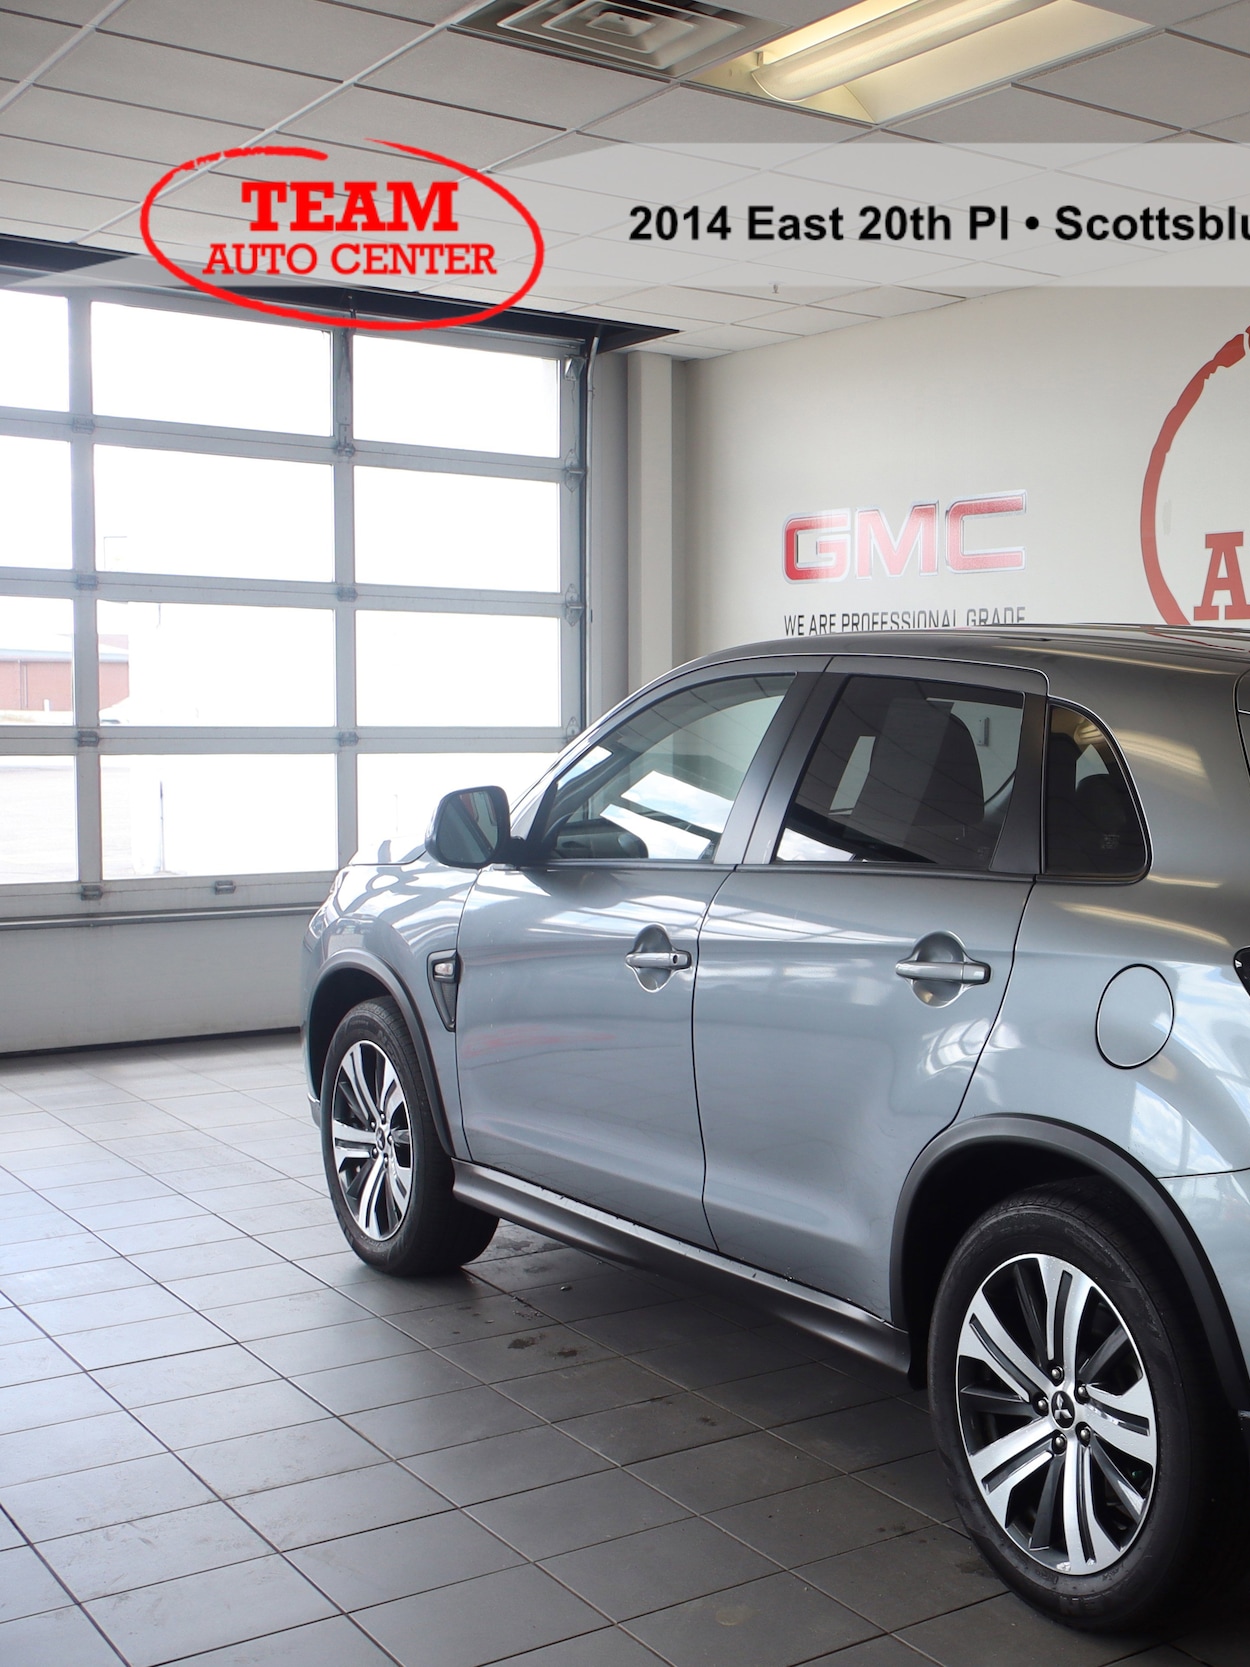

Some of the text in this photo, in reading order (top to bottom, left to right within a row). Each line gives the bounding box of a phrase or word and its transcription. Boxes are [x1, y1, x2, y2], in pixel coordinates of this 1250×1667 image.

[782, 488, 1028, 585] GMC
[784, 606, 1026, 636] WE ARE PROFESSIONAL GRADE
